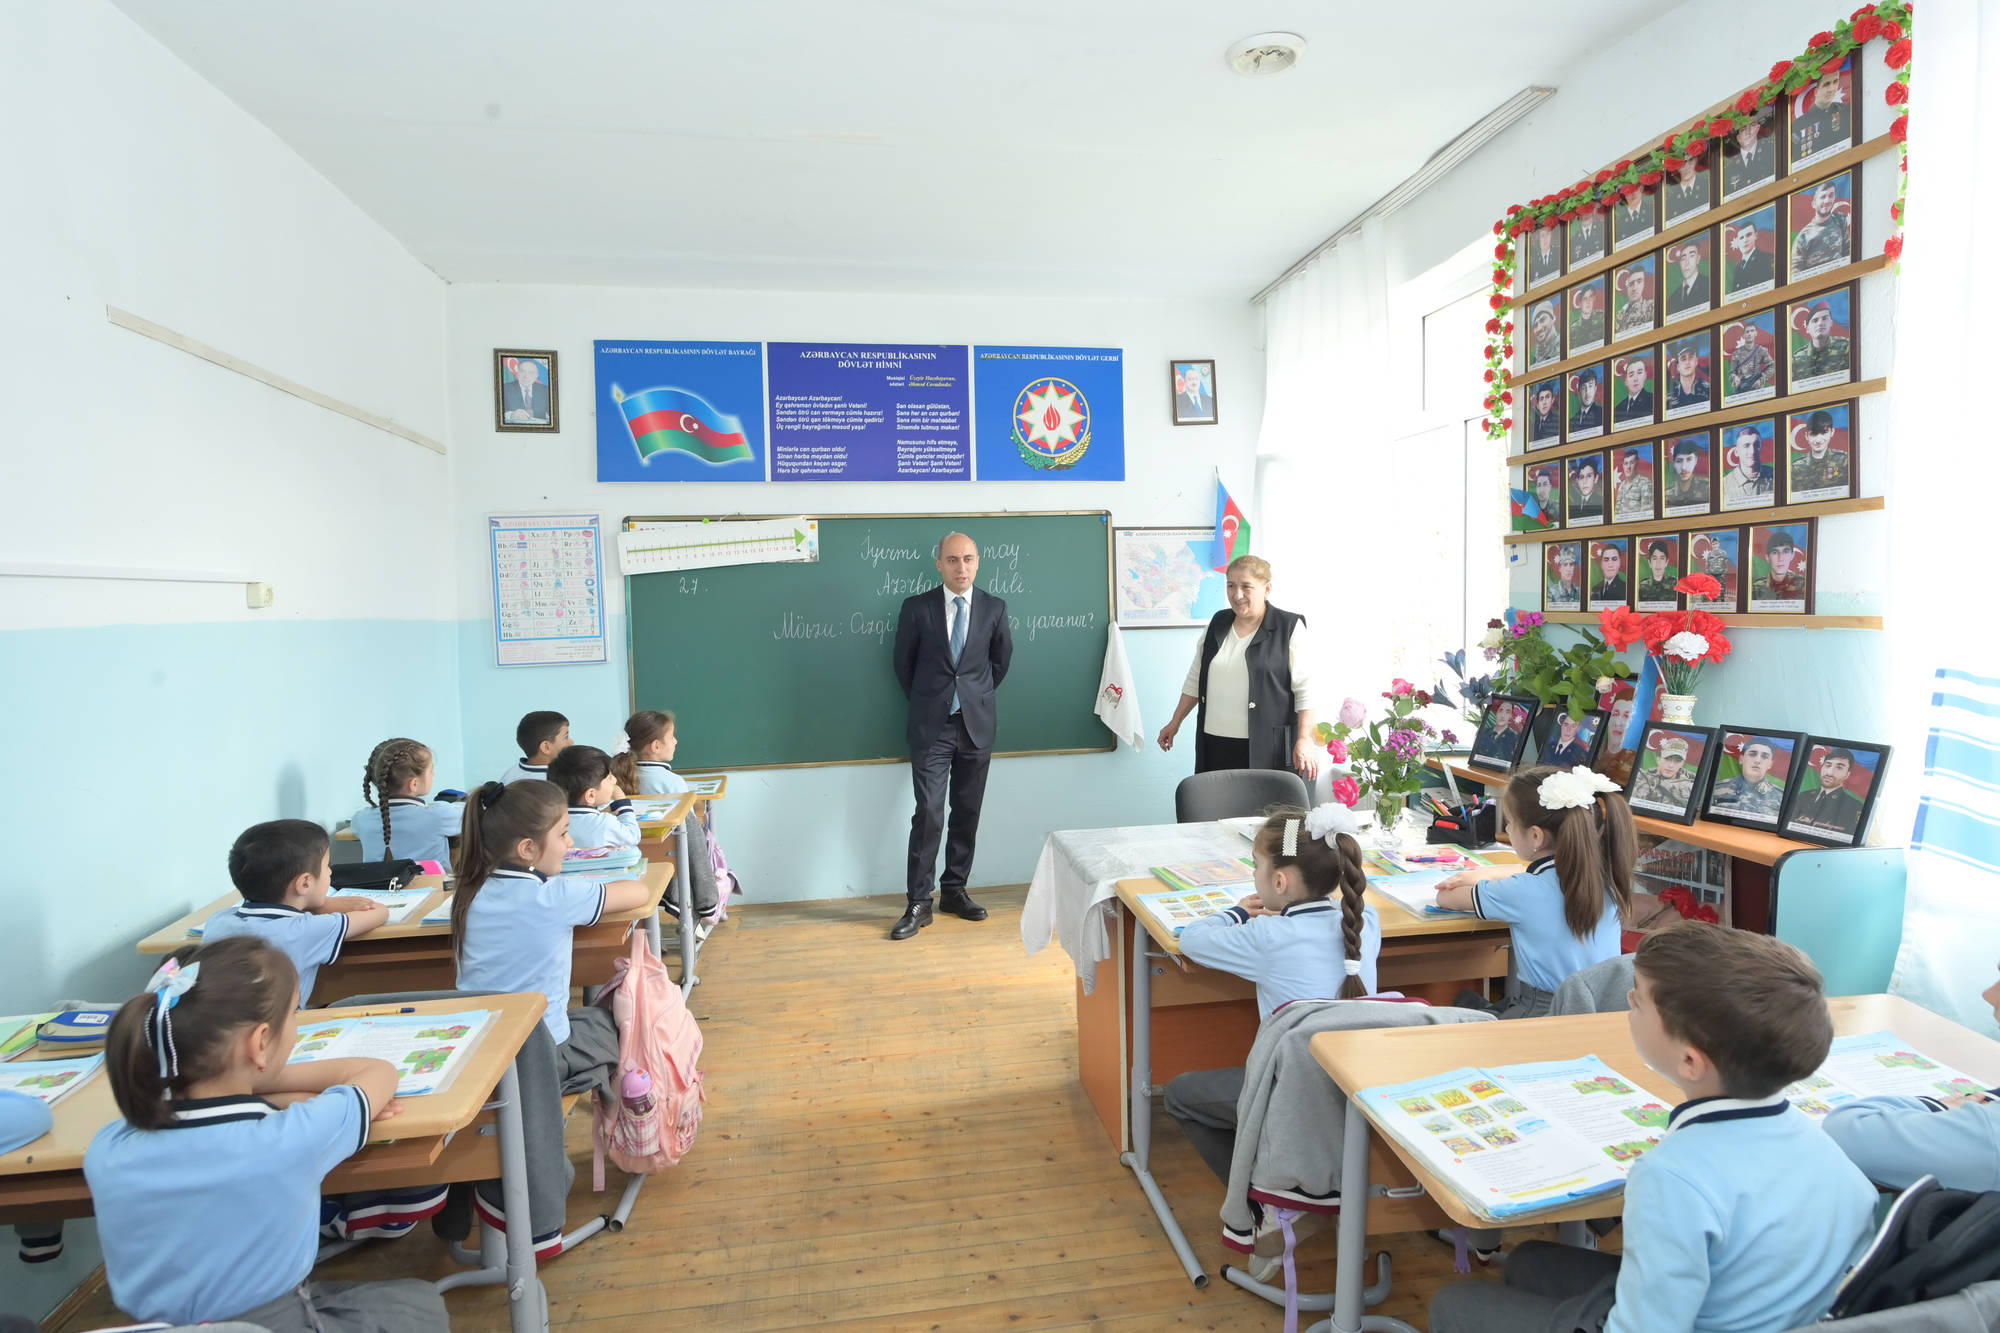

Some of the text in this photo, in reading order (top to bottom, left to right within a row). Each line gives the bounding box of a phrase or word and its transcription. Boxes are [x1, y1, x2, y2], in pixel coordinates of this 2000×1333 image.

[800, 351, 936, 360] AZƏRBAYCAN RESPUBLİKASININ
[838, 360, 902, 369] DÖVLƏT HİMNİ
